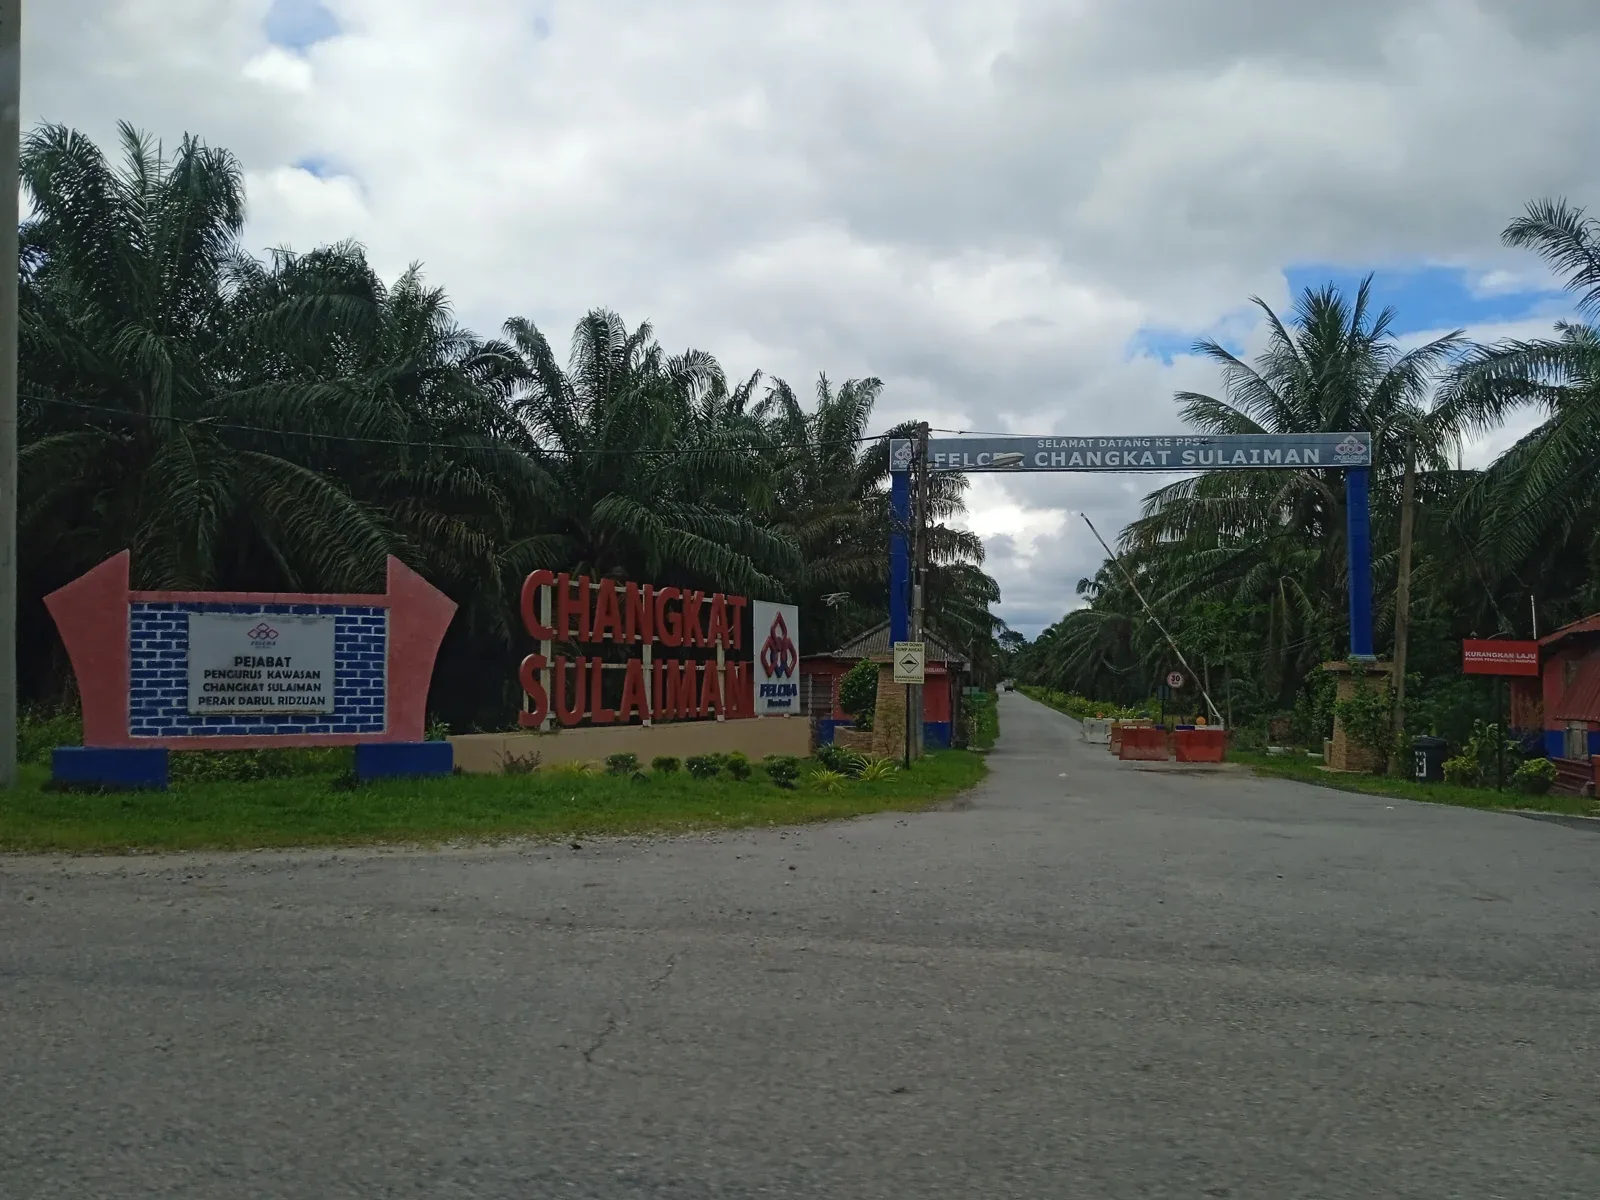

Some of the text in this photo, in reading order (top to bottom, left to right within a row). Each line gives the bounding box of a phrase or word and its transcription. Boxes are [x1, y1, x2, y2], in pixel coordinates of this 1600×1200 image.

[1037, 439, 1093, 448] SELAMAT
[1099, 438, 1150, 448] DATANG
[1155, 438, 1171, 447] KE
[1035, 451, 1171, 467] CHANGKAT
[1182, 448, 1320, 466] SULAIMAN
[520, 569, 747, 650] CHANGKAT
[234, 656, 292, 668] PEJABAT
[204, 669, 321, 680] PENGURUS KAWASAN
[203, 682, 322, 693] CHANGKAT SULAIMAN
[518, 653, 748, 728] SULAIMAN
[198, 696, 326, 706] PERAK DARUL RIDZUAN
